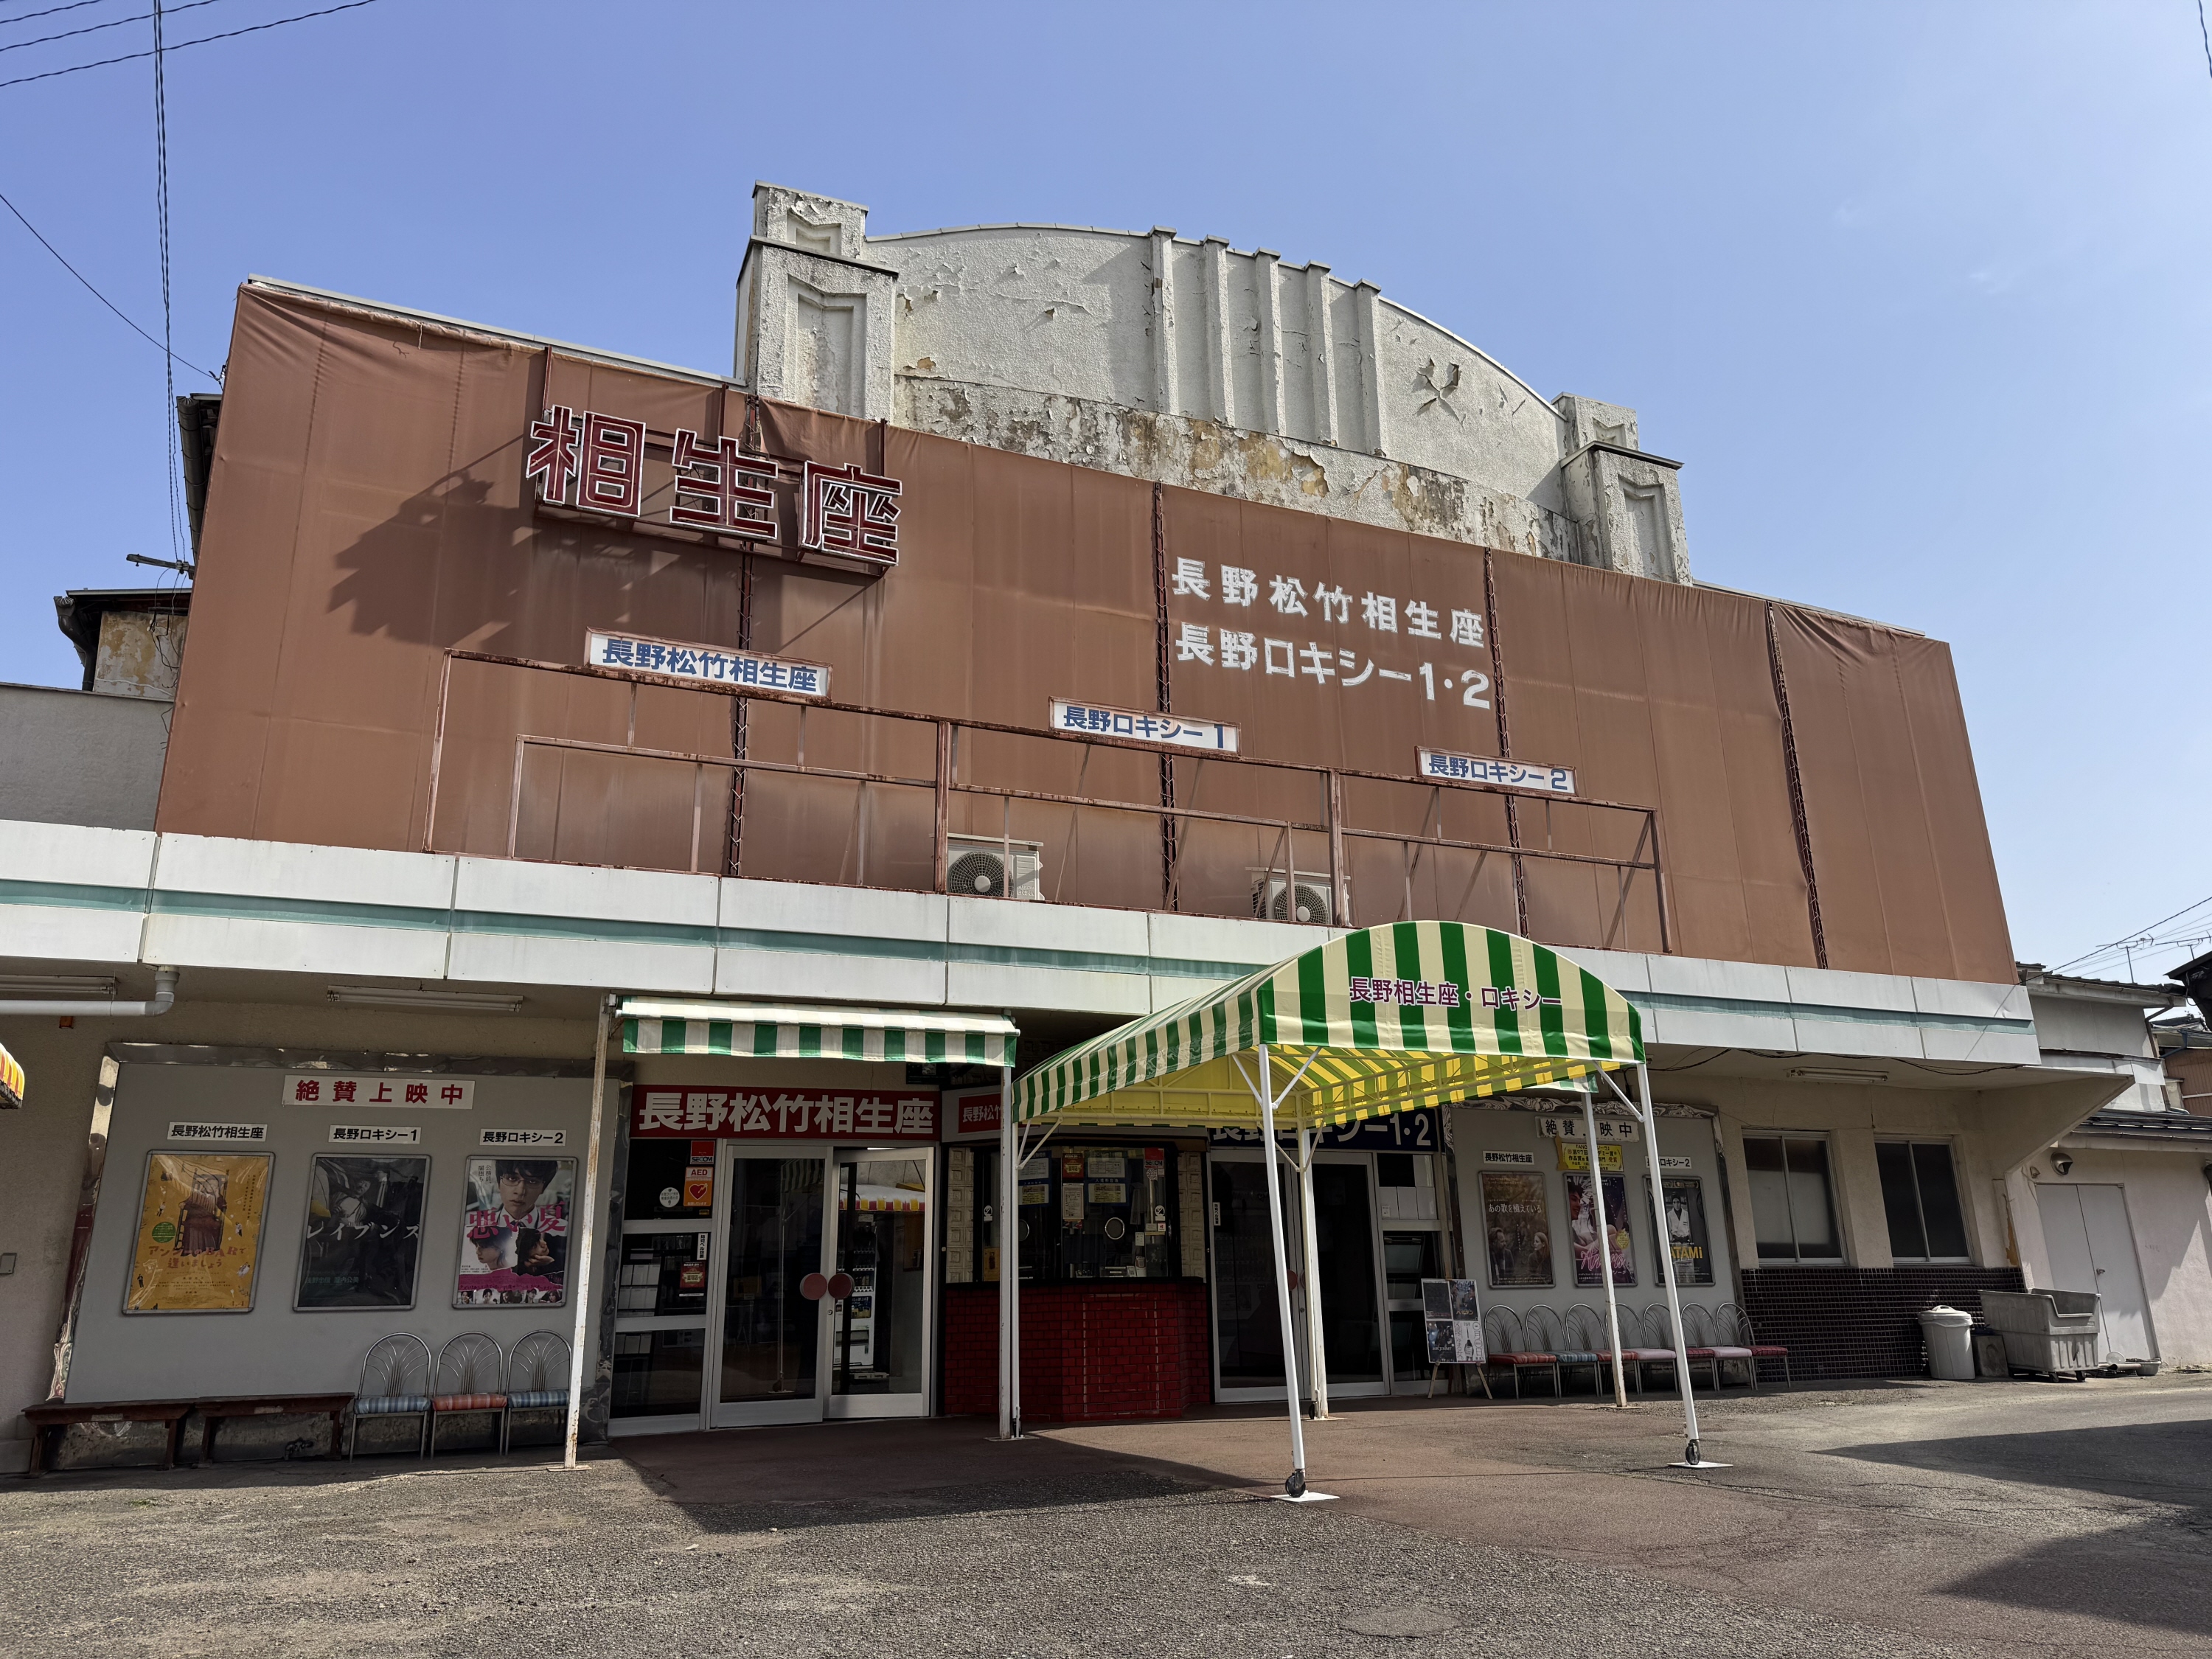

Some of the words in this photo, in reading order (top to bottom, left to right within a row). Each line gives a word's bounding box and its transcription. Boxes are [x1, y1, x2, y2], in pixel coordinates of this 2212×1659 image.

[526, 404, 902, 566] 相生座
[1172, 556, 1485, 649] 長野松竹相生座
[602, 639, 818, 693] 長野松竹相生座
[1175, 622, 1492, 709] 長野ロキシー1・2
[1349, 976, 1562, 1011] 長野相生座・ロキシー
[296, 1079, 465, 1105] 絶賛上映中
[639, 1093, 933, 1134] 長野松竹相生座
[171, 1125, 264, 1139] 長野松竹相生座
[333, 1128, 417, 1141] 長野ロキシー1
[482, 1130, 563, 1144] 長野ロキシー2
[1545, 1119, 1632, 1138] 絶賛映中
[1485, 1152, 1532, 1164] 長野松竹相生座
[1647, 1158, 1691, 1167] ロキシー2
[467, 1200, 566, 1239] 悪い夏
[1489, 1203, 1542, 1214] あの歌を憶えている
[306, 1219, 420, 1241] レイブンズ
[1671, 1246, 1703, 1259] ATAMi
